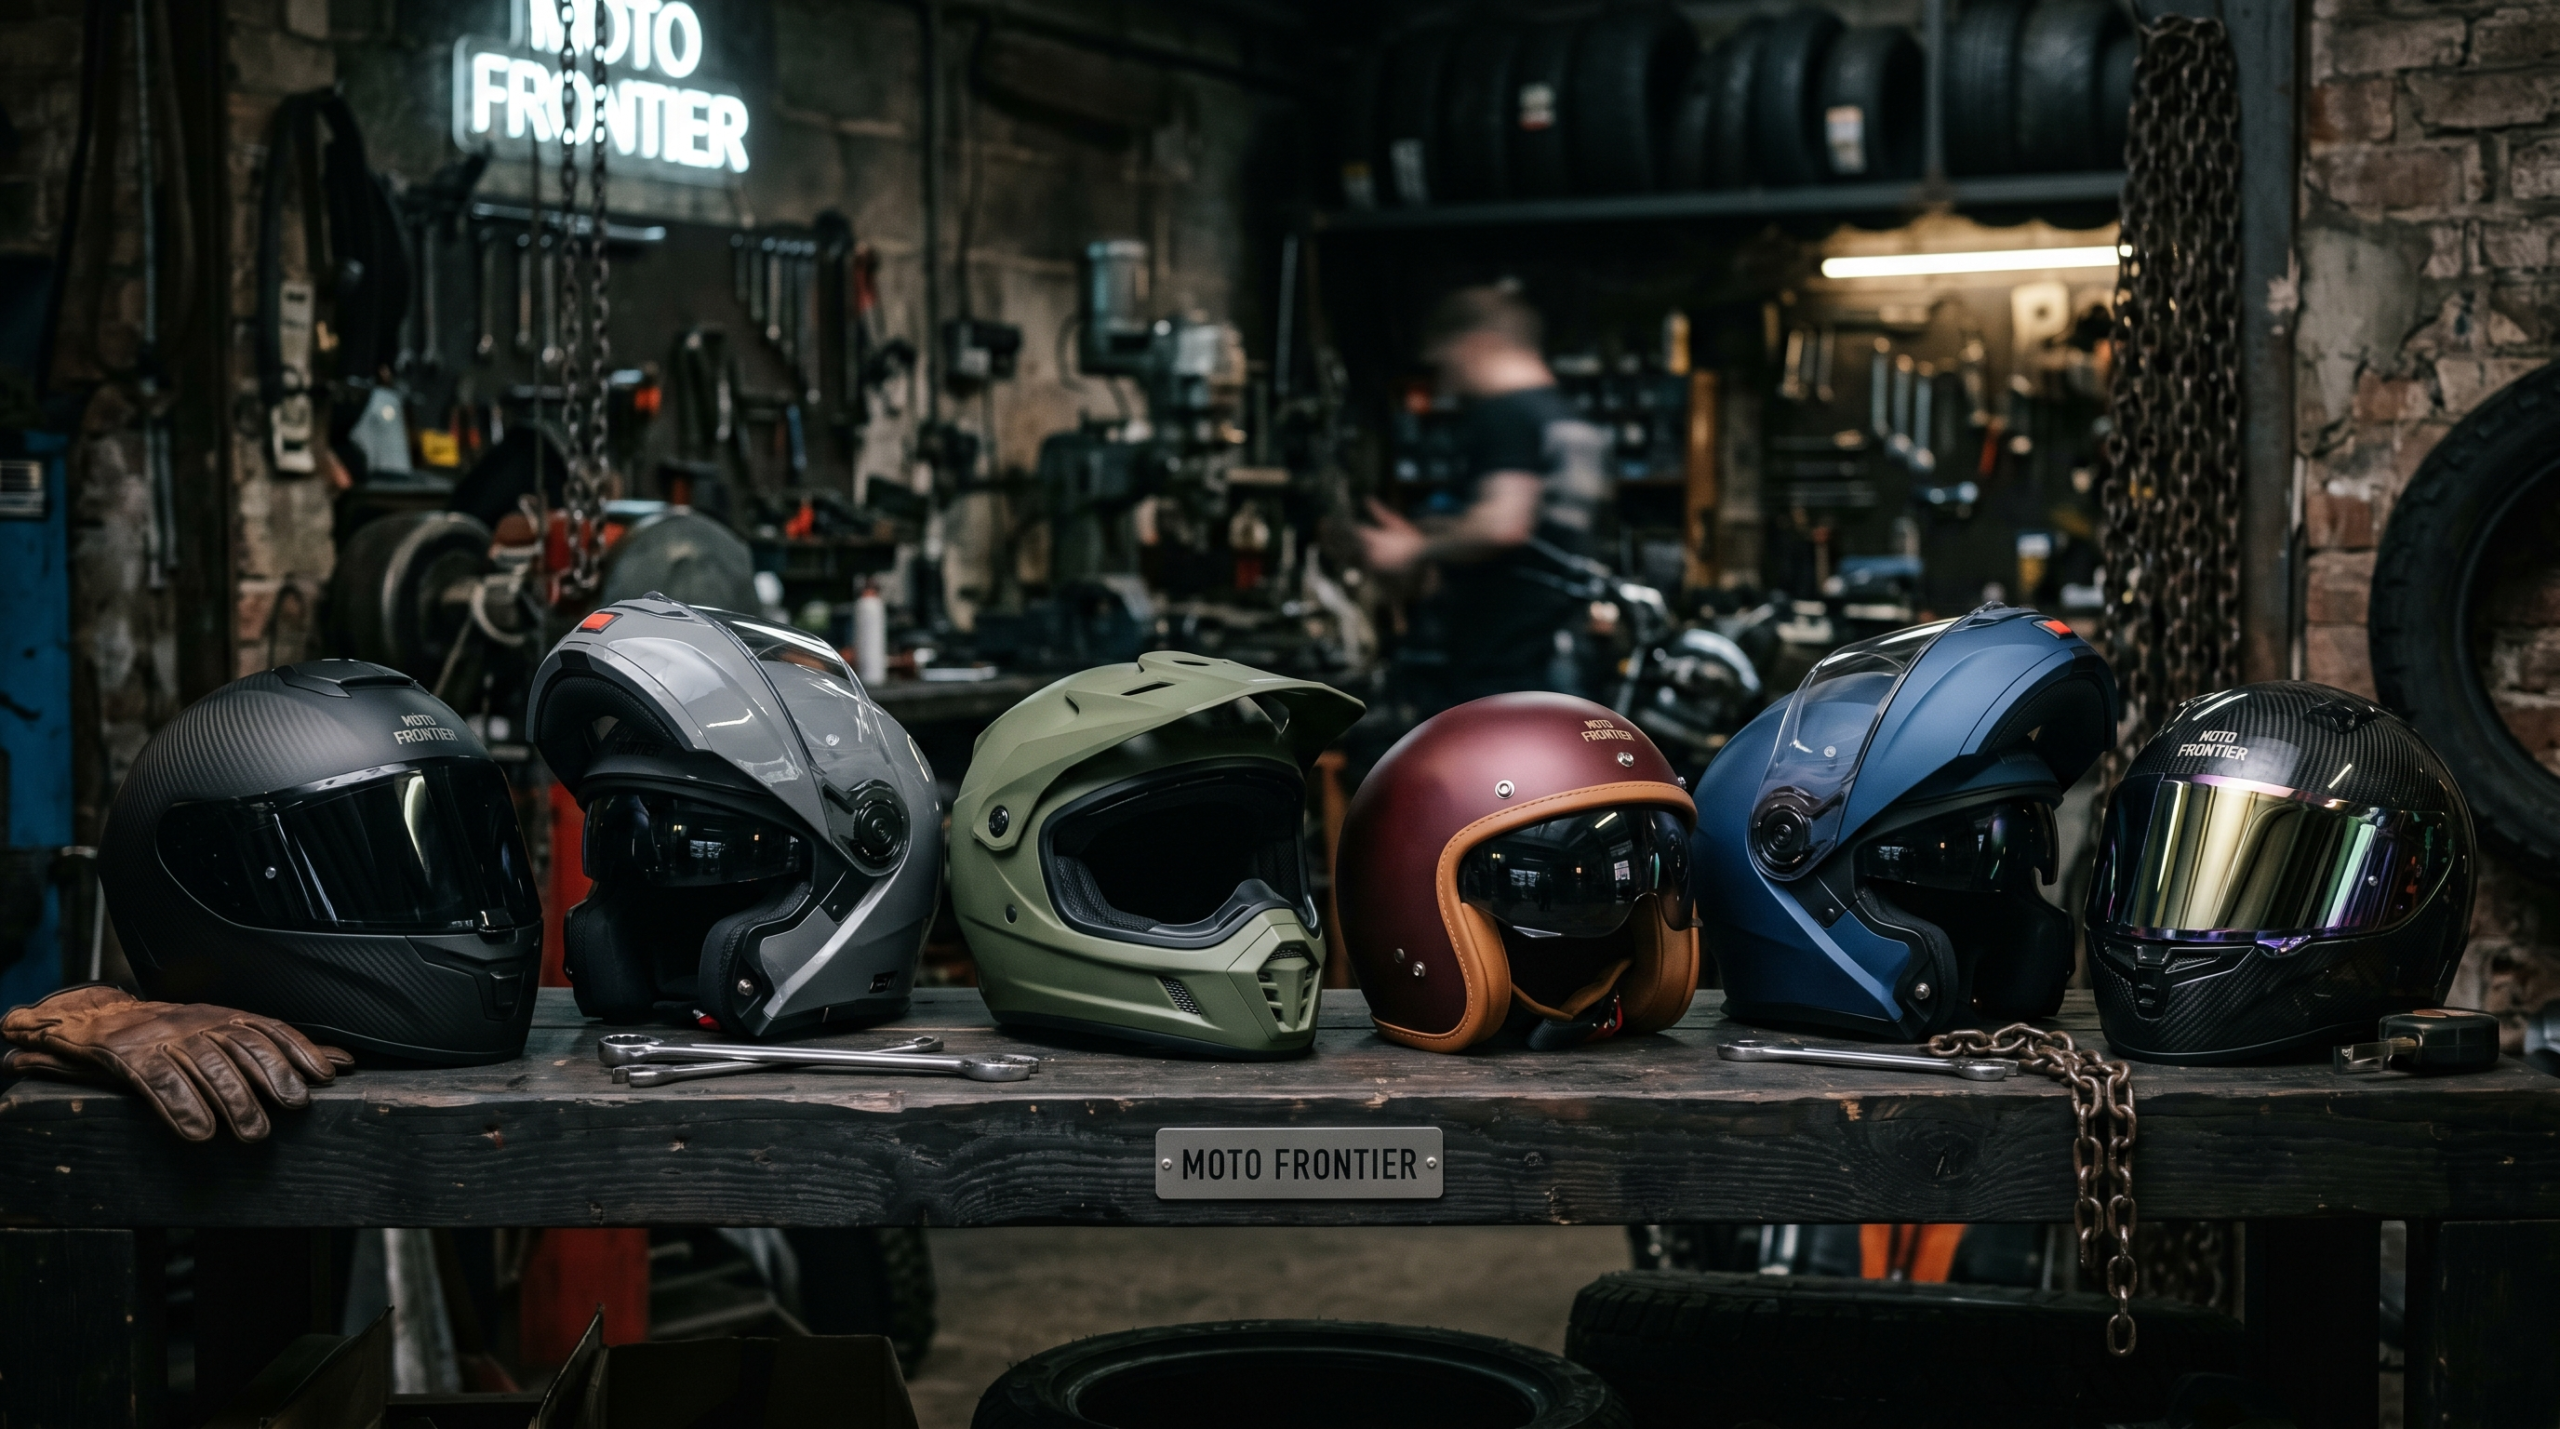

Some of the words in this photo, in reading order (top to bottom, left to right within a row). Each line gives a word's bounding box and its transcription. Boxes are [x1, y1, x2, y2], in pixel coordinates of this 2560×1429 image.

[472, 52, 750, 173] FRONTIER
[401, 713, 437, 727] MOTO
[1584, 719, 1614, 730] MOTO
[393, 727, 459, 745] FRONTIER
[1581, 729, 1636, 743] FRONTIER
[2177, 743, 2249, 761] FRONTIER
[1182, 1148, 1262, 1180] MOTO
[1275, 1148, 1418, 1180] FRONTIER
